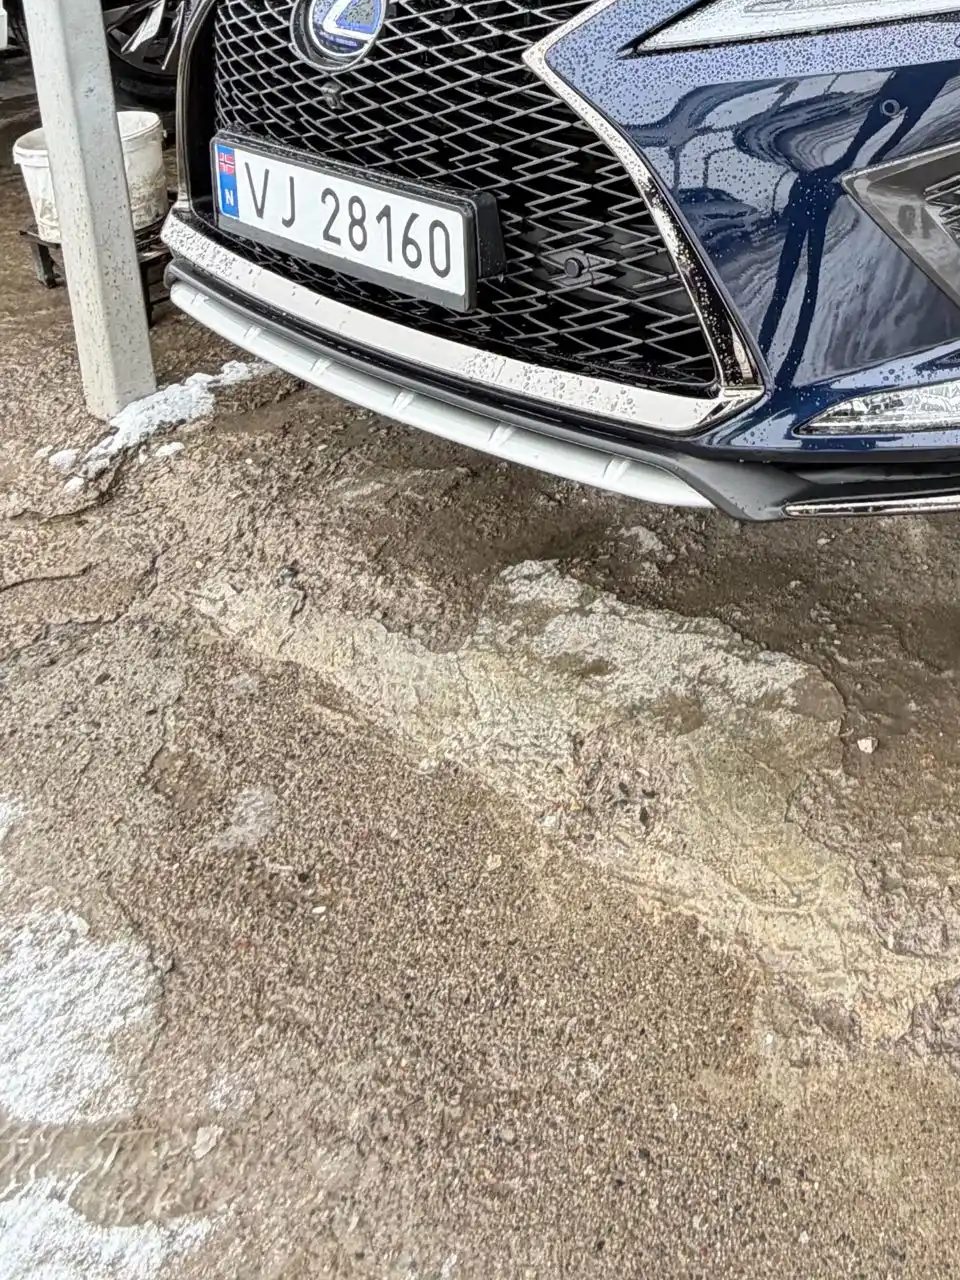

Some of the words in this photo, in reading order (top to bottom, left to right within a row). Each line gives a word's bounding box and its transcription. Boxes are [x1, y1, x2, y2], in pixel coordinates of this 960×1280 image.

[225, 188, 235, 206] N
[244, 162, 297, 228] VJ
[321, 187, 451, 278] 28160
